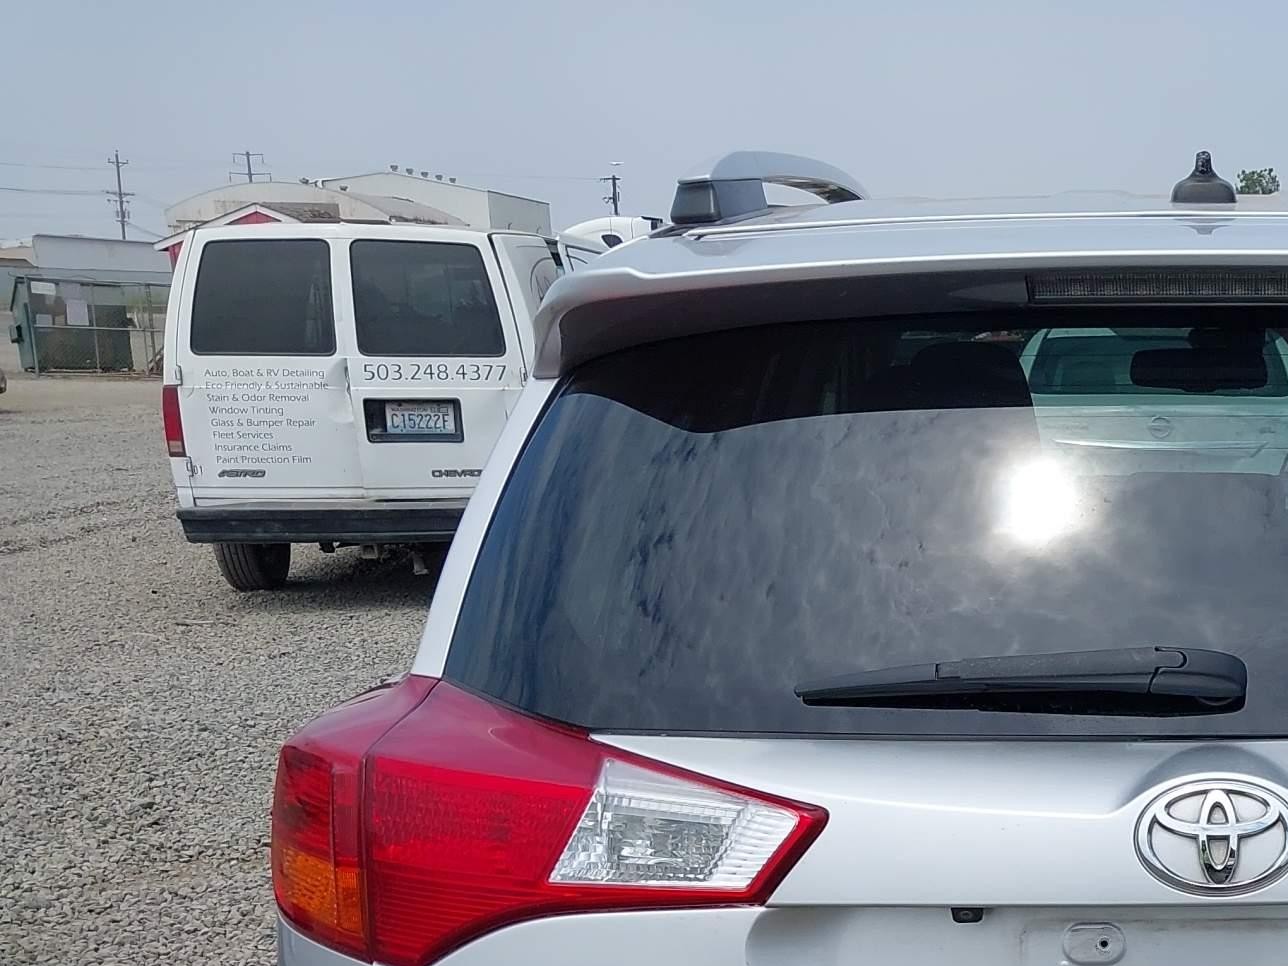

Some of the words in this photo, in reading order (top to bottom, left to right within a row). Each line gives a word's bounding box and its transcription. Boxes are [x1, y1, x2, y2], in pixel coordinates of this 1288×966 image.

[204, 368, 230, 379] Auto,
[232, 368, 254, 377] Boat
[256, 368, 264, 377] &
[266, 368, 280, 377] RV
[282, 368, 325, 379] Detailing
[363, 364, 507, 381] 503.248.4377
[205, 381, 223, 390] Eco
[225, 381, 262, 391] Friendly
[265, 381, 272, 390] &
[275, 381, 329, 390] Sustainable
[206, 393, 230, 402] Stain
[231, 393, 239, 402] &
[241, 393, 266, 402] Odor
[268, 393, 310, 402] Removal
[208, 406, 249, 414] Window
[251, 406, 284, 416] Tinting
[210, 418, 234, 427] Glass
[236, 418, 244, 427] &
[246, 418, 283, 428] Bumper
[286, 418, 316, 428] Repair
[391, 413, 450, 430] C15222F
[212, 430, 234, 439] Fleet
[236, 430, 274, 439] Services
[214, 443, 260, 452] Insurance
[261, 443, 293, 452] Claims
[216, 455, 240, 464] Paint
[241, 455, 290, 464] Protection
[292, 455, 312, 464] Film
